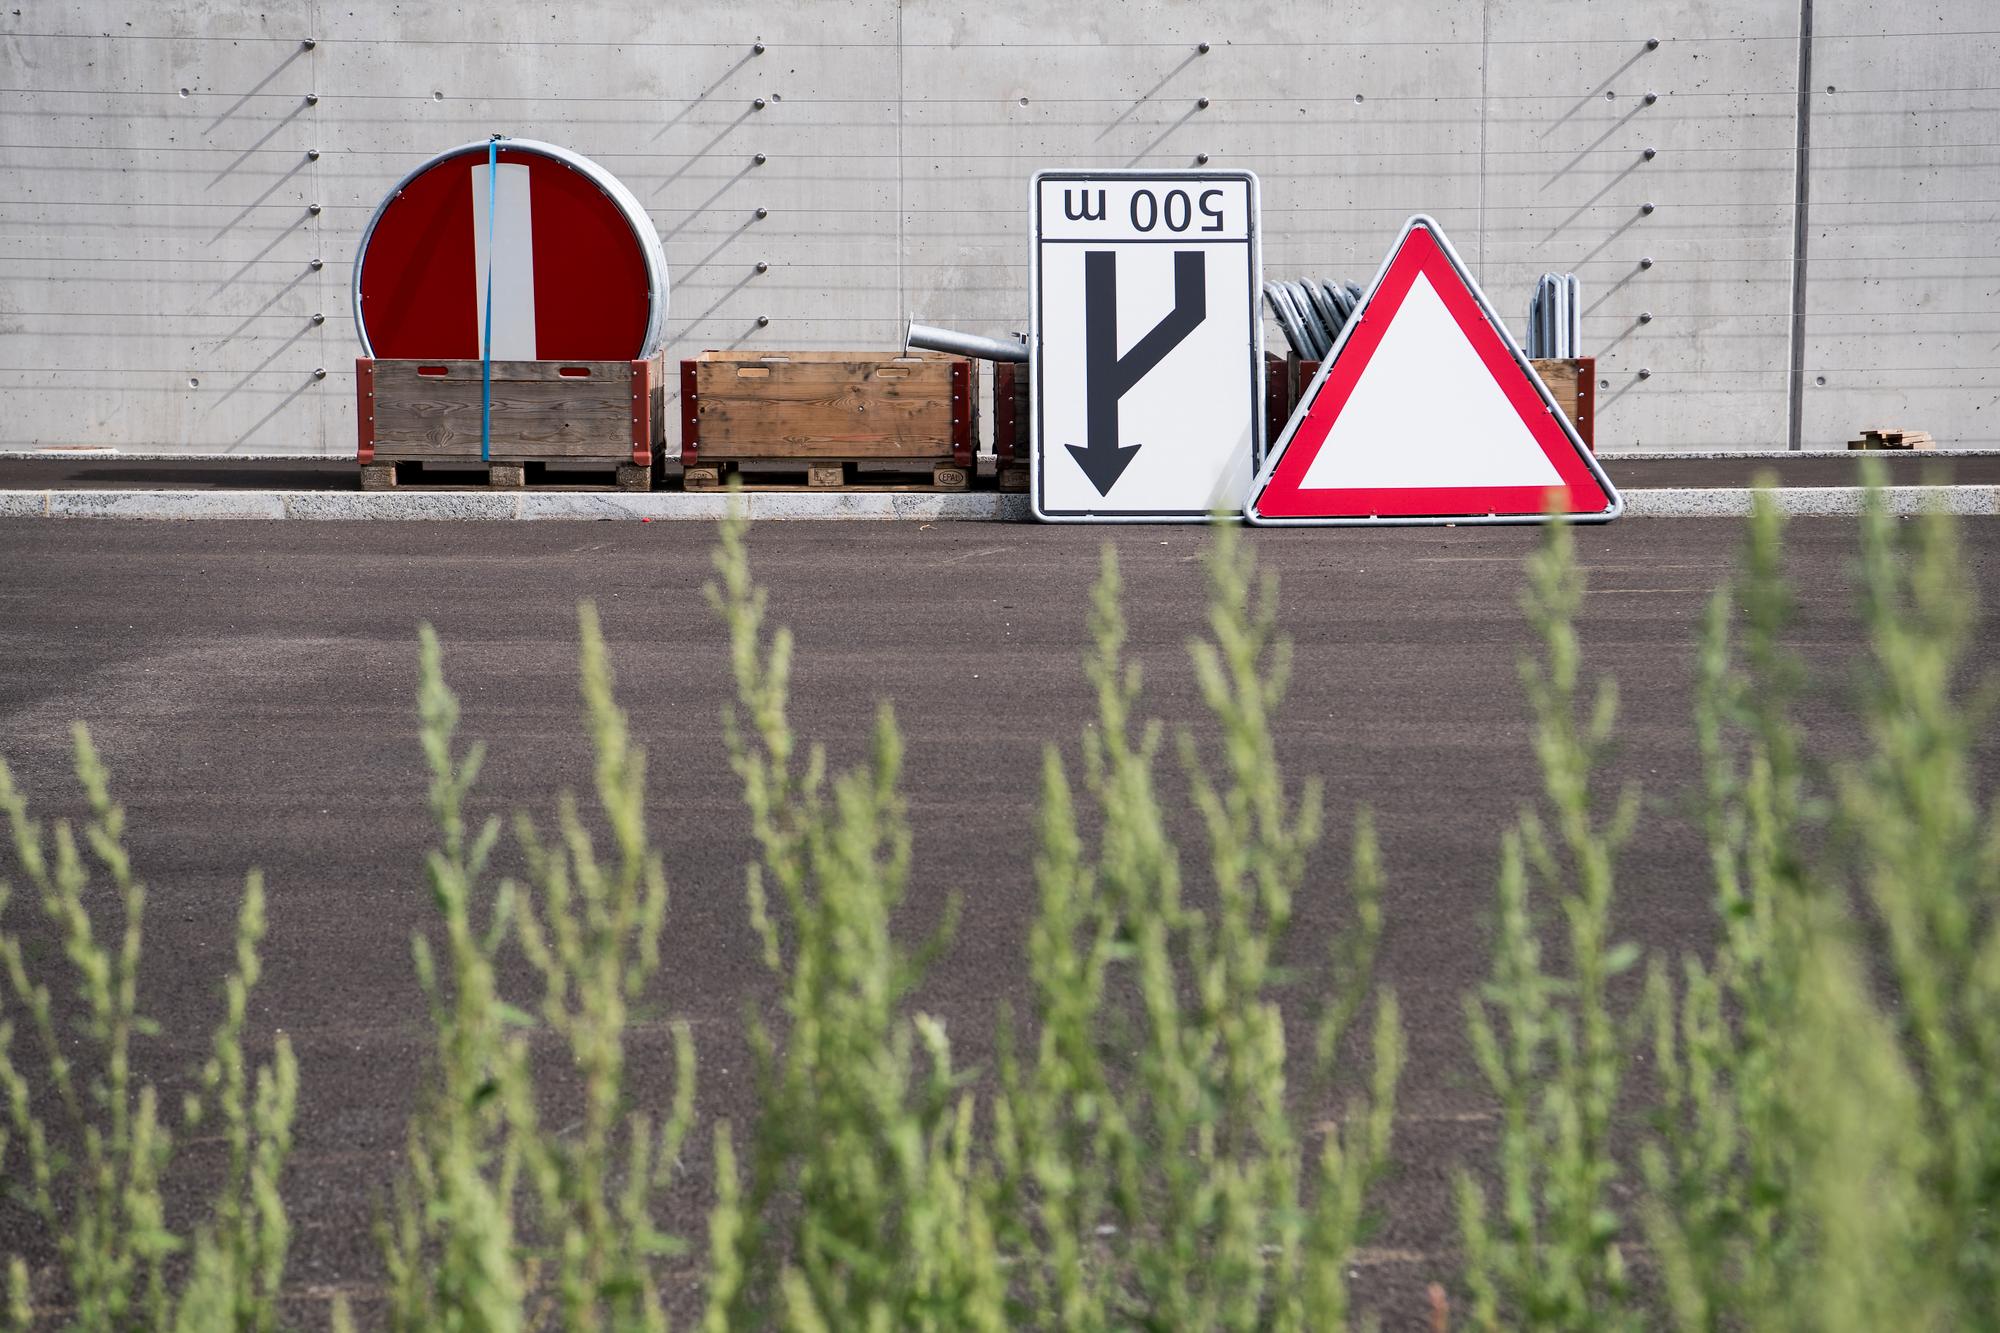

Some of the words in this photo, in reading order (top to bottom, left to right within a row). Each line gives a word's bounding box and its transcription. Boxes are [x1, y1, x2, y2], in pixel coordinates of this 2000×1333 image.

[1064, 189, 1106, 221] m
[1130, 189, 1224, 232] 500
[942, 473, 960, 482] EPAL
